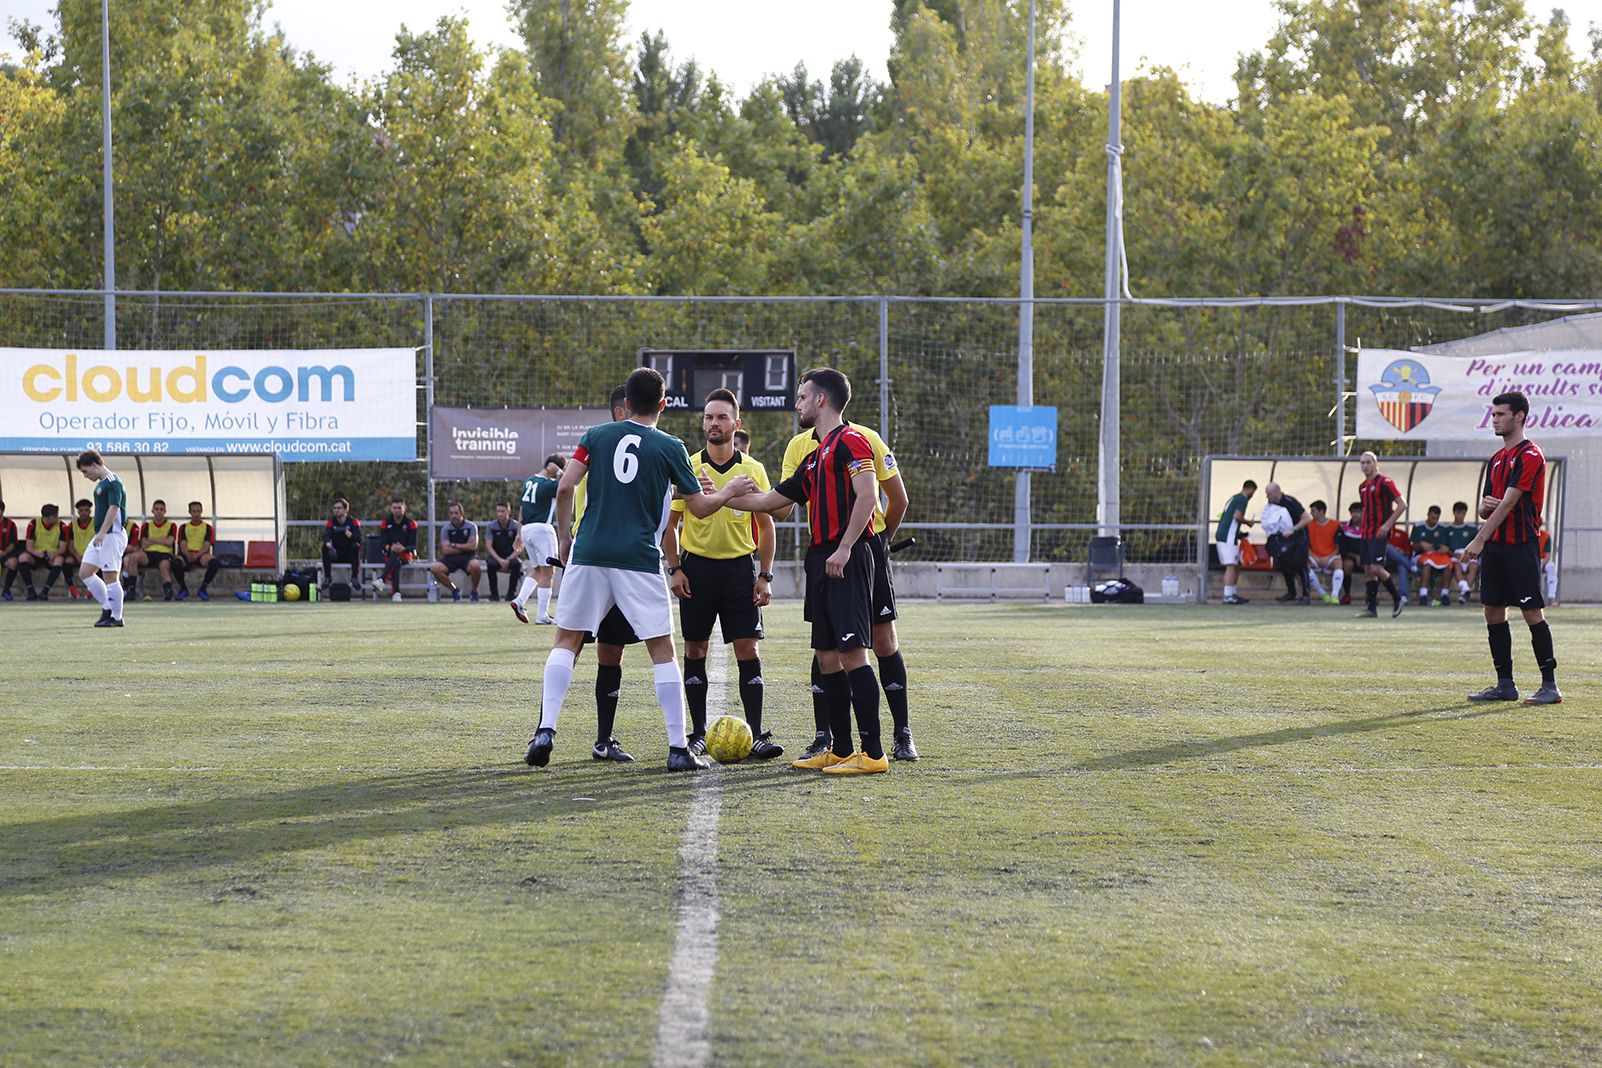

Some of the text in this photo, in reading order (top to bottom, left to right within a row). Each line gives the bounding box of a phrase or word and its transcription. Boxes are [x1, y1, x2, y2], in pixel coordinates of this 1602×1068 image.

[22, 353, 355, 403] cloudcom
[1466, 359, 1602, 381] Per un cam
[664, 396, 786, 407] CAL VISITANT
[39, 410, 339, 434] Operador Fijo, Móvil y Fibra
[452, 427, 519, 438] Invisible
[106, 442, 130, 453] 586
[134, 442, 150, 453] 30
[153, 442, 169, 453] 82
[226, 440, 351, 453] www.cloudcom.cat
[455, 438, 516, 454] training
[613, 433, 642, 484] 6
[521, 480, 539, 504] 21
